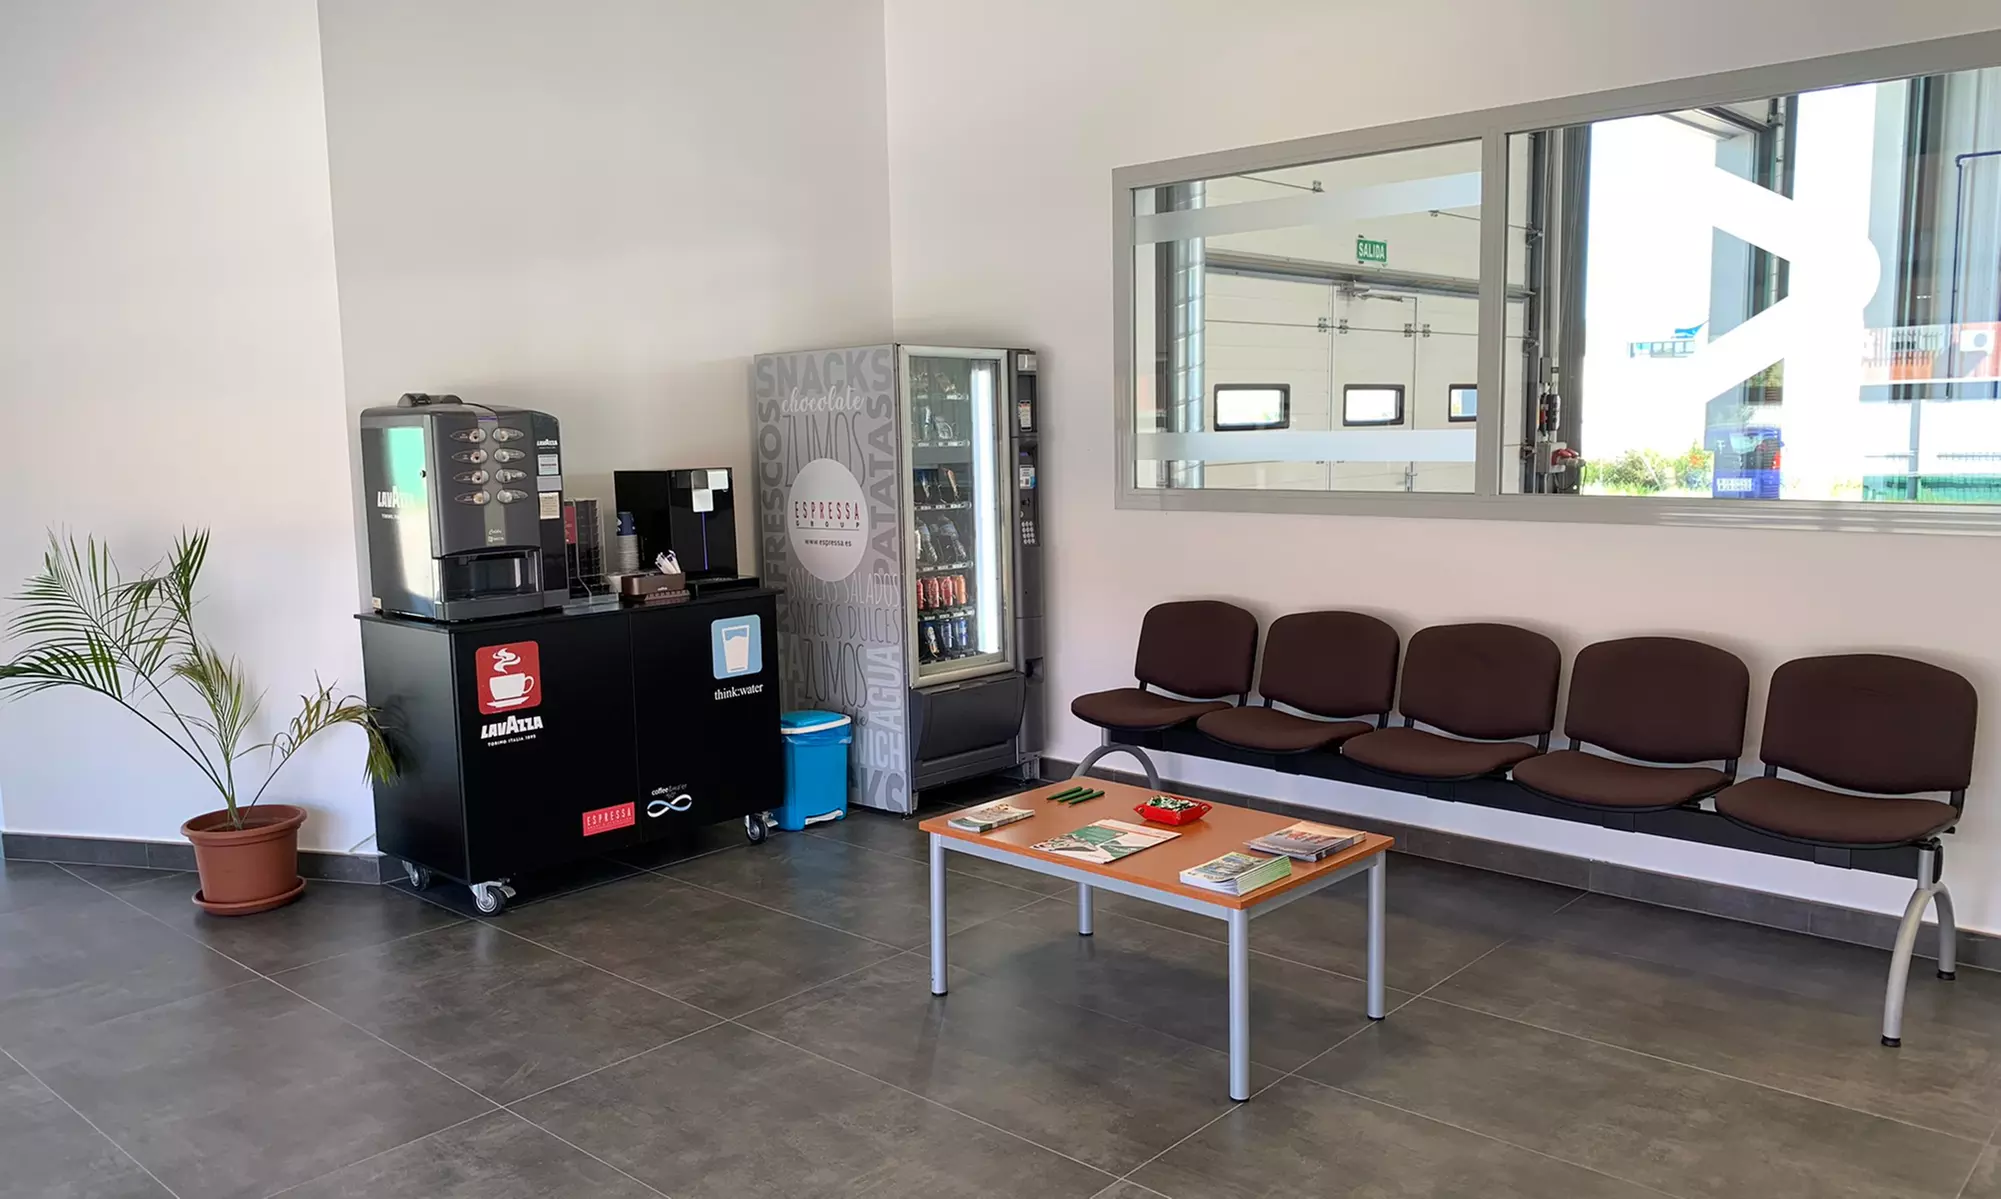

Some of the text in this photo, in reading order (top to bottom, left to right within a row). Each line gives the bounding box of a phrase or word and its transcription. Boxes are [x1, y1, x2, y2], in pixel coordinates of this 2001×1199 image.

[1359, 243, 1385, 259] SALIDA
[756, 347, 893, 399] SNACKS
[781, 385, 865, 413] chocolate
[795, 501, 860, 520] ESPRESSA
[796, 520, 860, 528] GROUP
[789, 567, 900, 608] SNACKS SALADOS
[789, 600, 900, 645] SNACKS DULCES
[802, 638, 868, 708] ZUMOS
[866, 645, 903, 732] AGUA
[480, 715, 544, 739] LAVAZZA
[587, 807, 632, 826] ESPRESSA
